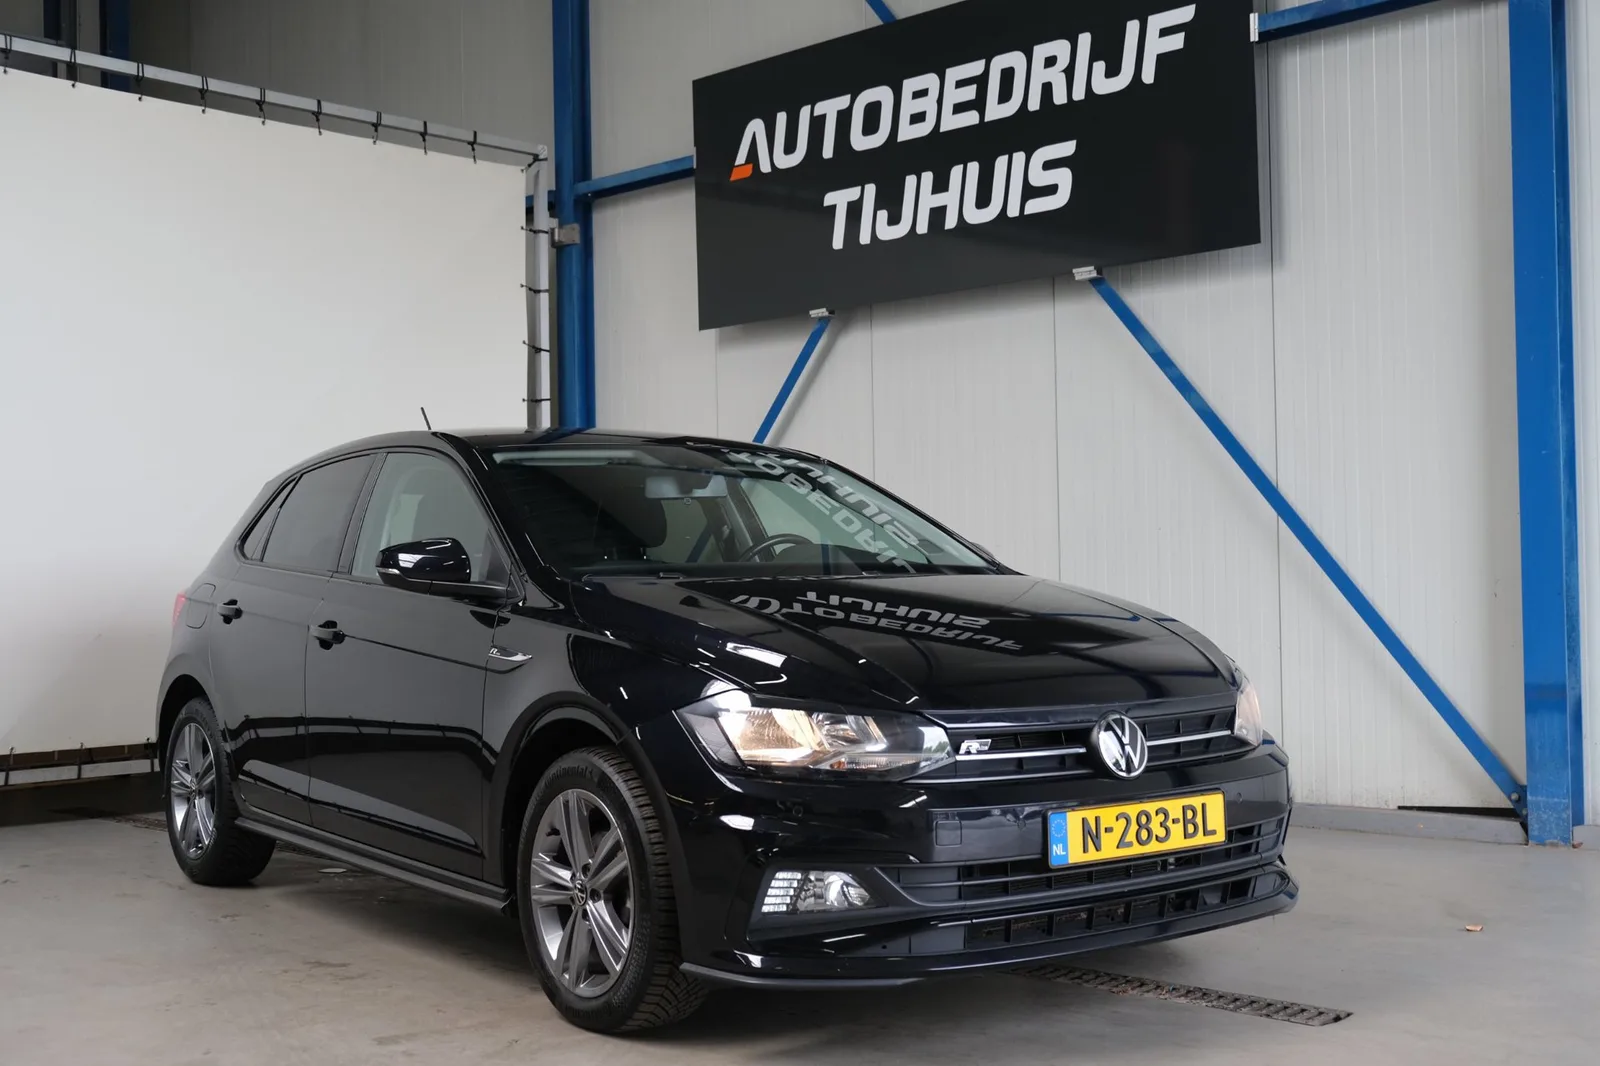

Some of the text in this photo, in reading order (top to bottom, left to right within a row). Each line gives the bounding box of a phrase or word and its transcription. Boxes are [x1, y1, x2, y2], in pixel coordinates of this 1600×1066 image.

[729, 4, 1197, 182] AUTOBEDRIJF
[822, 139, 1078, 250] TIJHUIS
[1052, 843, 1066, 857] NL
[1081, 802, 1217, 854] N-283-BL
